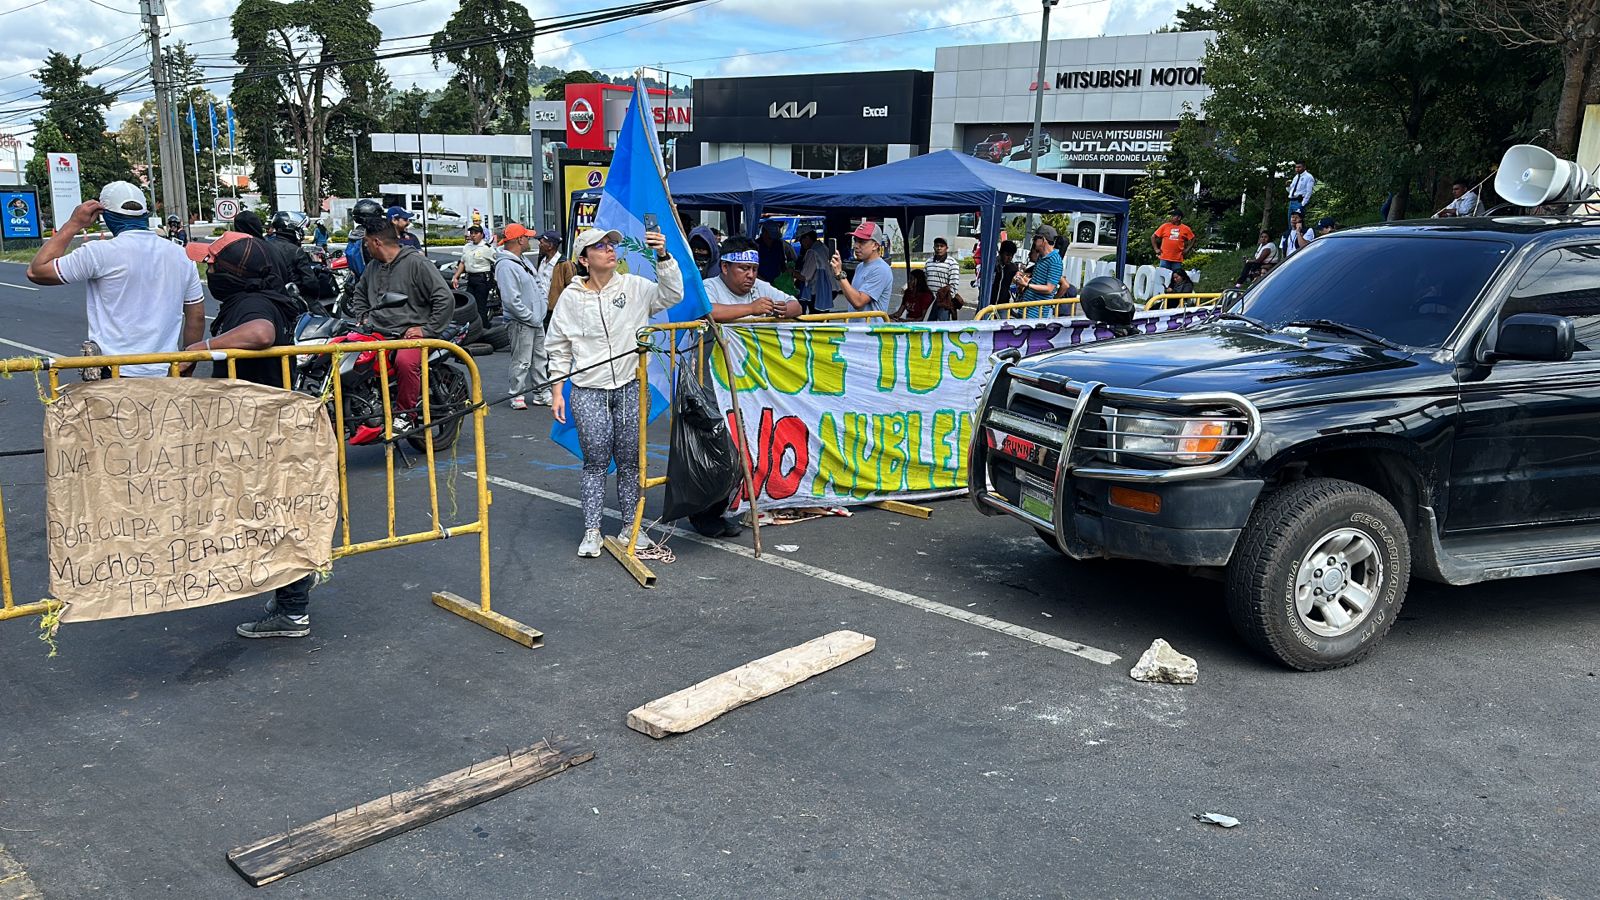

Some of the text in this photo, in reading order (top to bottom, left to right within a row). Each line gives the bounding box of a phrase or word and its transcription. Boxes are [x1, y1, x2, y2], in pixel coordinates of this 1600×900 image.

[1056, 69, 1142, 89] MITSUBISHI
[535, 110, 558, 121] Excel
[769, 101, 817, 118] KIA
[862, 105, 888, 117] Excel
[1059, 141, 1173, 152] OUTLANDER
[1072, 130, 1163, 140] NUEVA MITSUBISHI
[1059, 154, 1098, 162] GRANDIOSA
[1100, 154, 1113, 162] POR
[1115, 154, 1140, 162] DONDE
[1141, 154, 1151, 162] LA
[10, 217, 29, 225] 60%
[222, 203, 233, 211] 70
[709, 326, 849, 396] QUE
[867, 324, 978, 393] TUS
[57, 394, 257, 446] APOYANDO
[45, 449, 91, 477] UNA
[726, 407, 810, 510] NO
[127, 471, 233, 504] MEJOR
[48, 520, 92, 548] POR
[98, 517, 159, 541] CULPA
[171, 514, 188, 532] DE
[237, 492, 338, 522] CORRUPTOS
[49, 552, 155, 588] MUCHOS
[168, 526, 287, 574] PERDERAN
[119, 559, 270, 612] TRABAJO
[1350, 512, 1400, 643] GEOLANDAR A/T
[1285, 560, 1319, 652] YOKOHAMA
